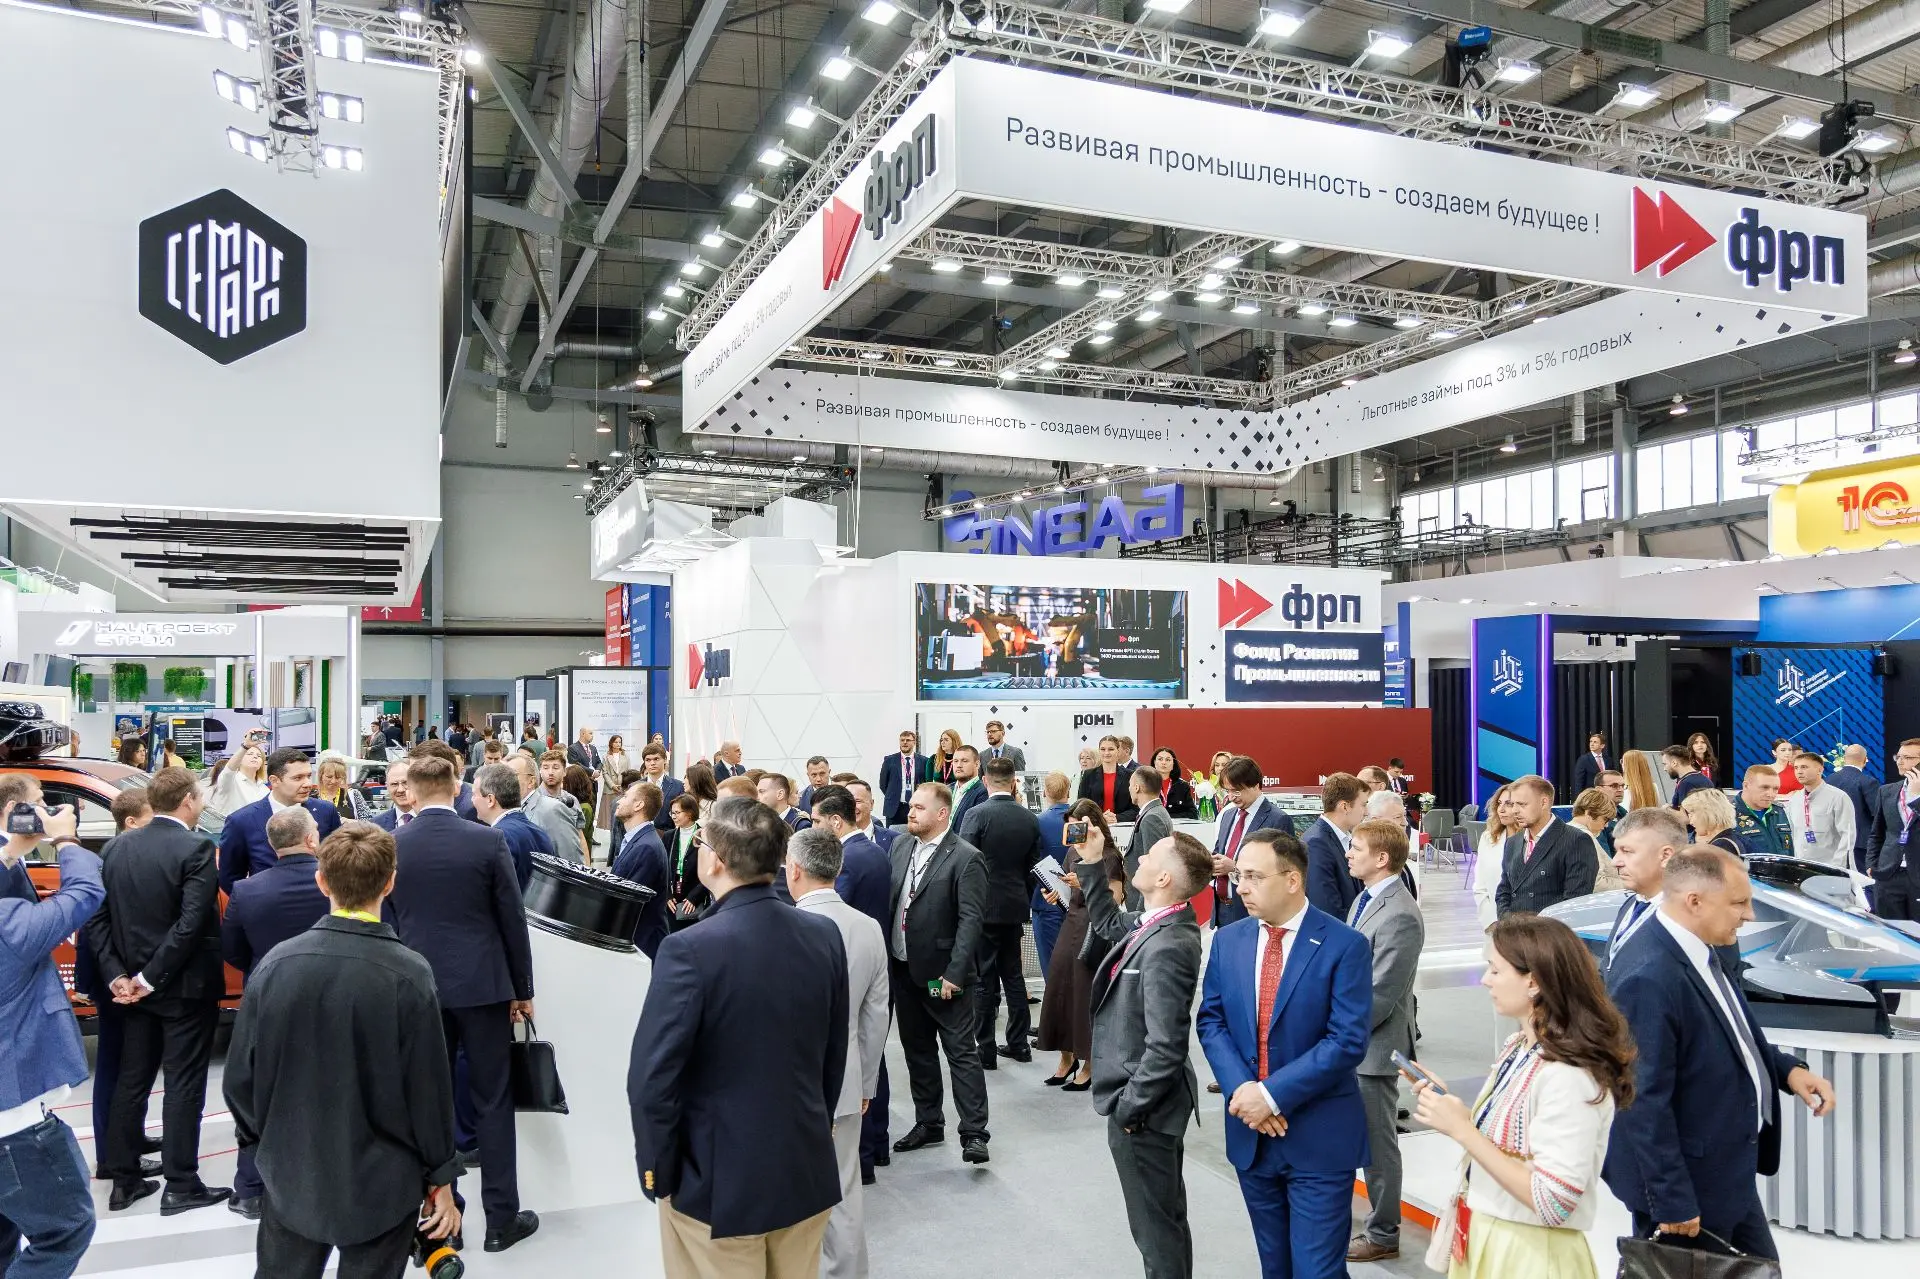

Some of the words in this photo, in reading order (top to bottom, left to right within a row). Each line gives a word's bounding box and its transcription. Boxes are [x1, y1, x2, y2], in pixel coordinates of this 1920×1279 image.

[864, 113, 937, 241] фрп
[1007, 116, 1139, 163] Развивая
[1149, 146, 1372, 199] промышленность
[1395, 187, 1490, 218] создаем
[1497, 198, 1589, 233] будущее
[1727, 207, 1845, 292] фрп
[1361, 394, 1418, 421] Льготные
[1421, 381, 1463, 405] займы
[1467, 372, 1493, 392] под
[1496, 363, 1517, 383] 3%
[1521, 361, 1530, 376] и
[1535, 351, 1557, 371] 5%
[1561, 331, 1633, 364] годовых
[816, 398, 890, 418] Развивая
[895, 408, 1027, 429] промышленность
[1040, 420, 1100, 437] создаем
[1104, 424, 1162, 441] будущее
[1281, 583, 1361, 630] фрп
[1234, 643, 1281, 661] Фонд
[1283, 643, 1359, 661] Развития
[1234, 664, 1381, 684] Промышленности
[1262, 776, 1280, 787] фрп
